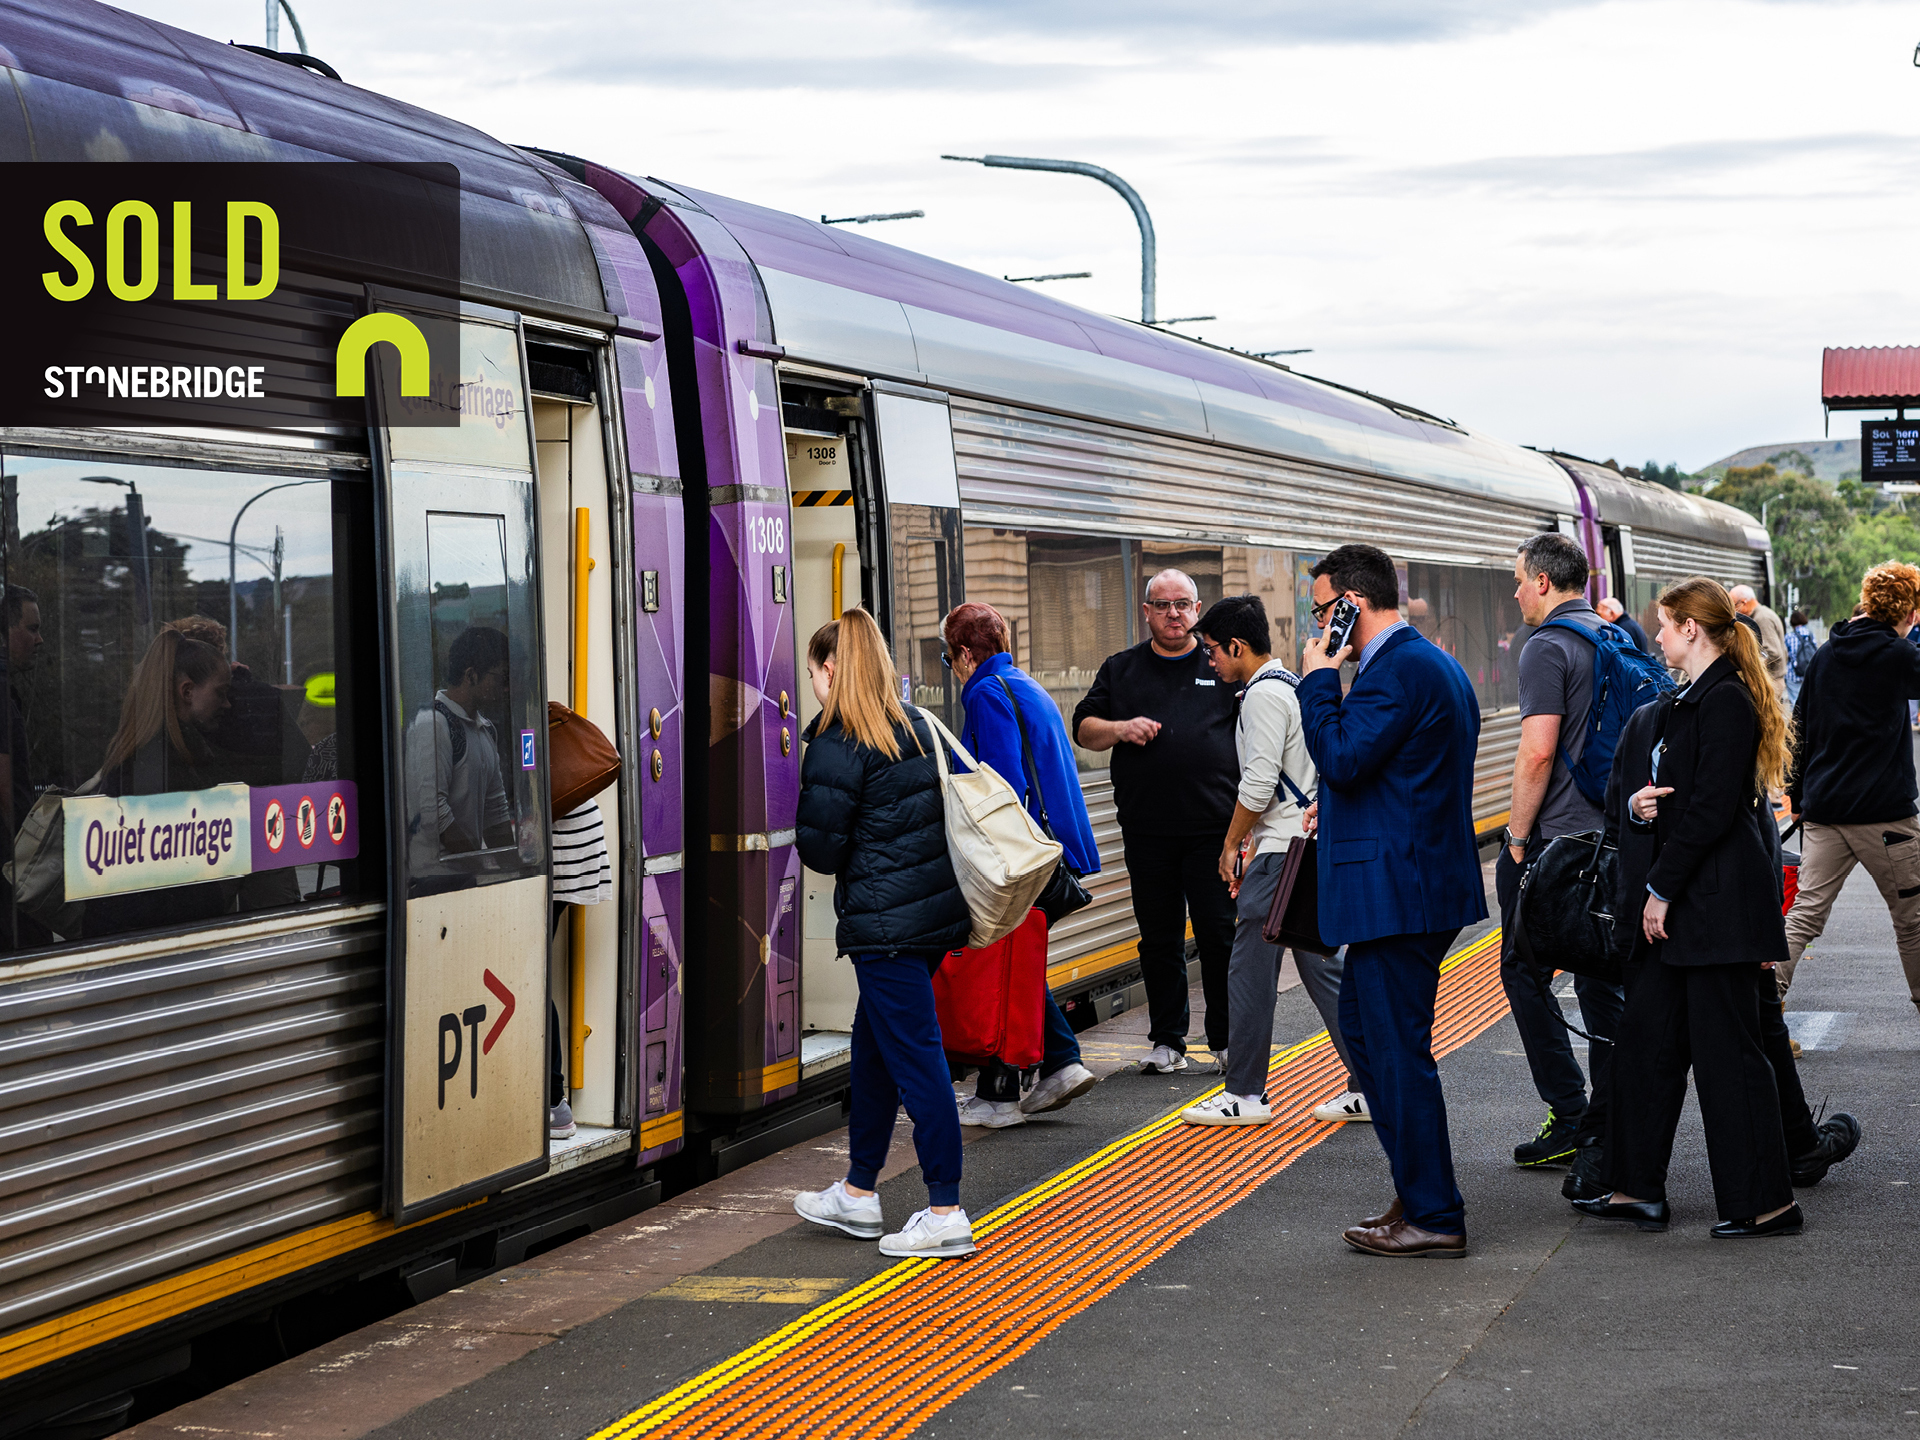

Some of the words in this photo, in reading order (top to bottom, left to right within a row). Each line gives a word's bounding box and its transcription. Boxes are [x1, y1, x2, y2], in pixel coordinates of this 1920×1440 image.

[806, 447, 836, 459] 1308
[749, 516, 784, 554] 1308
[86, 815, 146, 876] Quiet
[151, 808, 232, 866] carriage
[438, 1004, 487, 1110] PT
